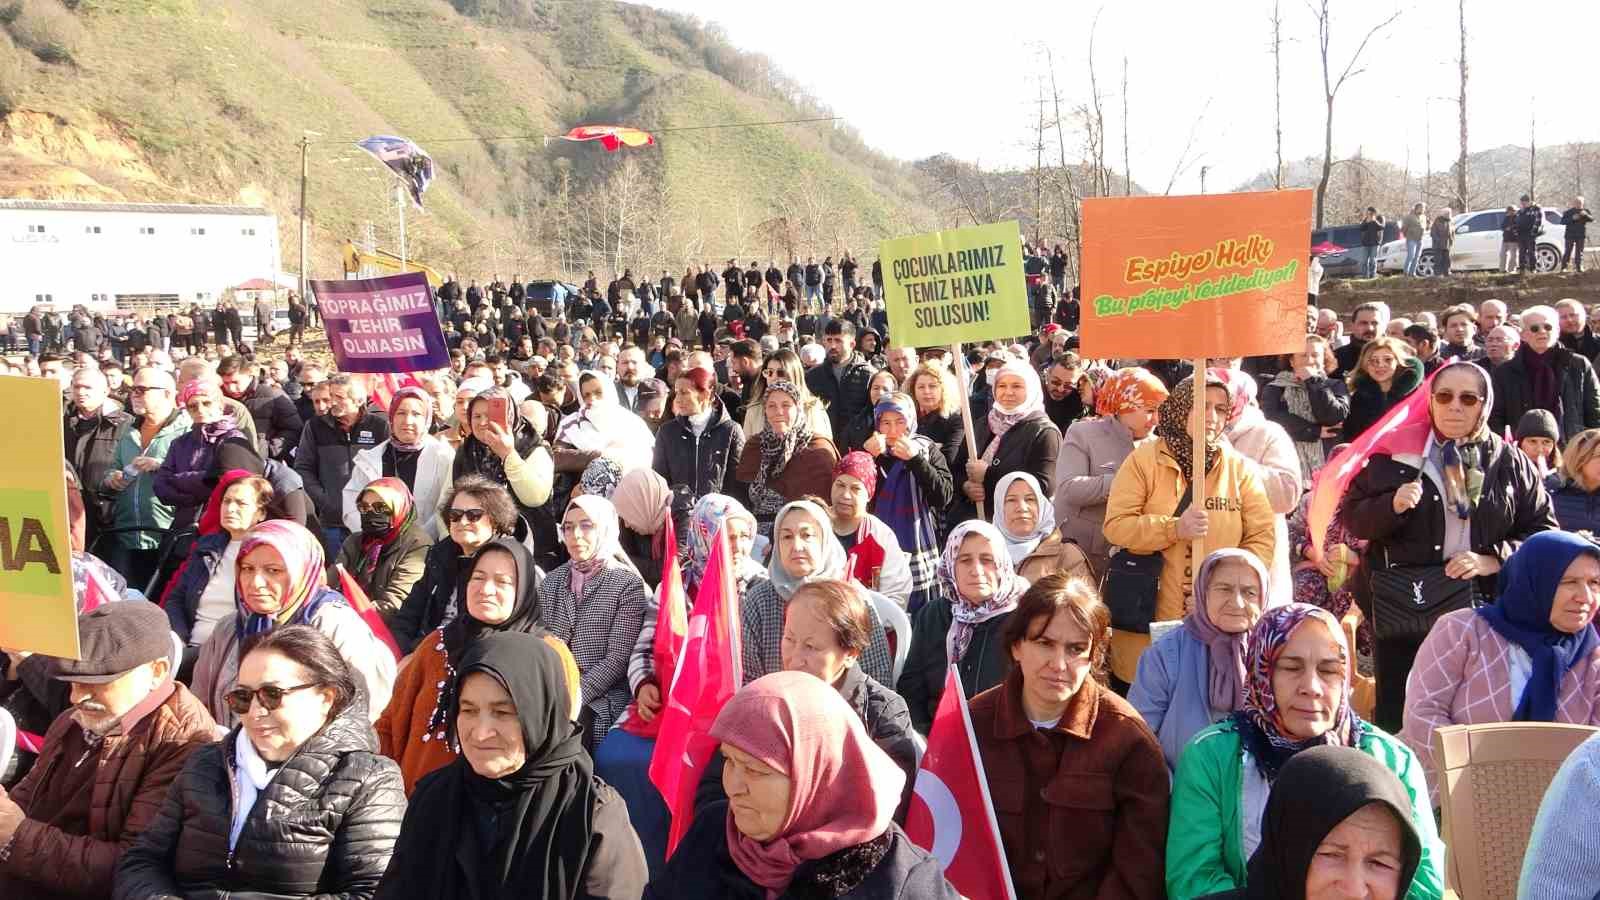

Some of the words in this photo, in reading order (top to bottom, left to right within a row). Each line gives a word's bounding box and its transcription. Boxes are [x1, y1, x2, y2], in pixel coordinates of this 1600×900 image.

[892, 245, 1006, 286] ÇOCUKLARIMIZ
[1125, 249, 1213, 283] Espiye
[1215, 235, 1273, 267] Halkı
[904, 276, 949, 304] TEMİZ
[951, 273, 996, 299] HAVA
[1095, 295, 1125, 317] Bu
[1126, 283, 1192, 316] projeyi
[1192, 259, 1298, 300] reddediyor!
[320, 292, 429, 314] TOPRAĞIMIZ
[914, 301, 990, 329] SOLUSUN!
[348, 313, 401, 334] ZEHİR
[342, 334, 426, 354] OLMASIN
